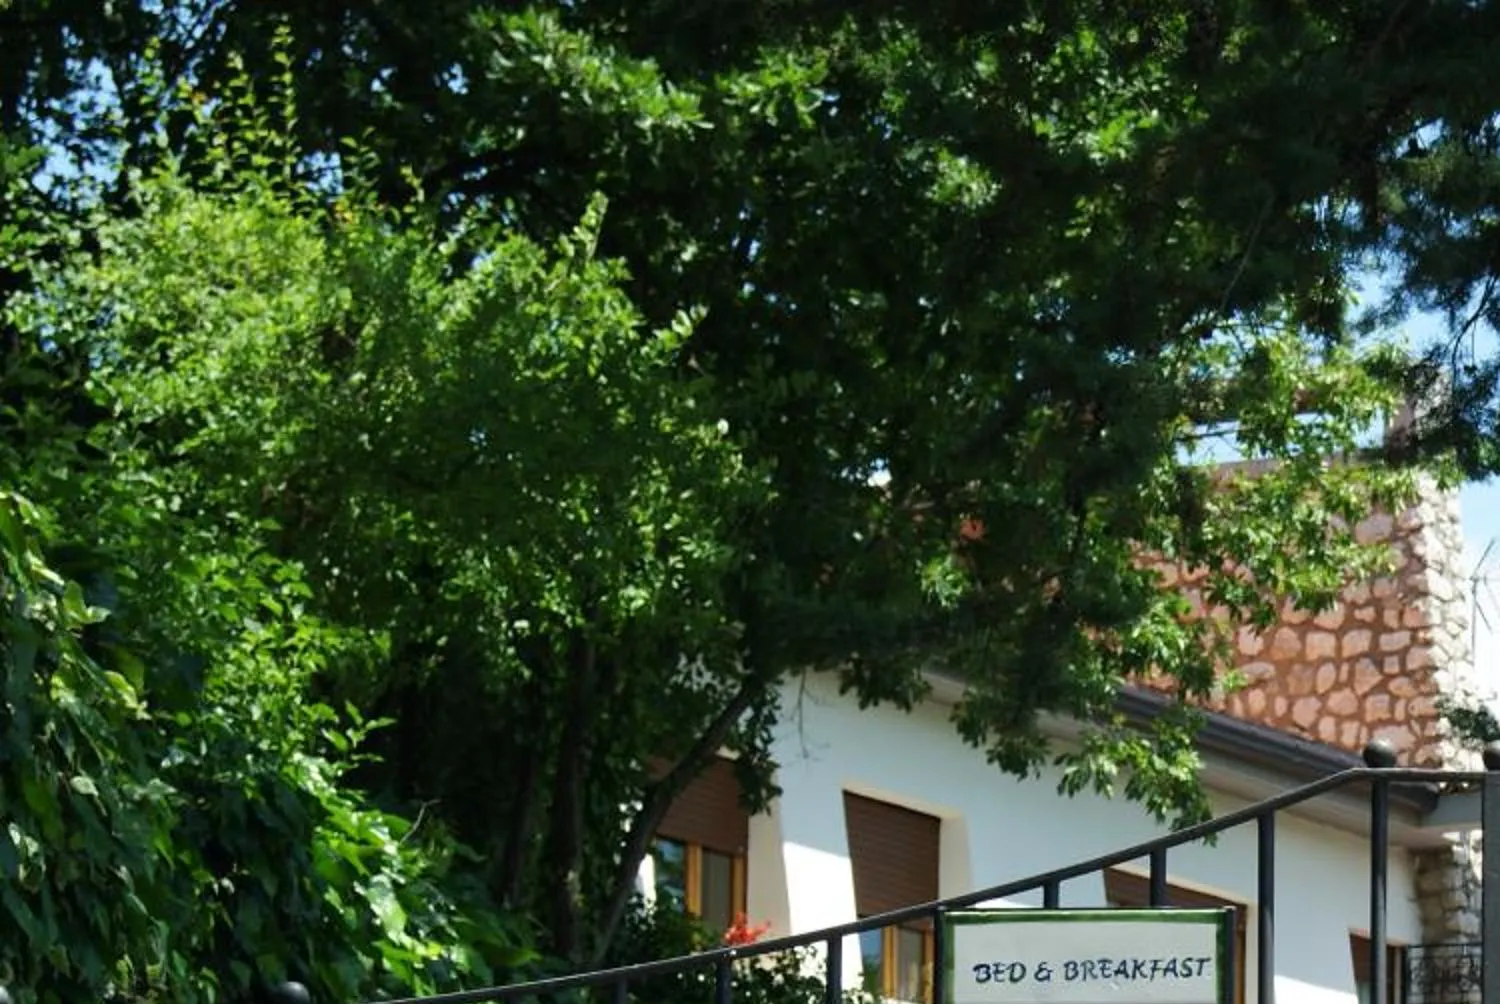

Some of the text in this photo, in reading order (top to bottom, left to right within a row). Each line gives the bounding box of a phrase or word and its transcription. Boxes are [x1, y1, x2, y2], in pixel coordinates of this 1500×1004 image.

[973, 957, 1211, 984] BED & BREAKFAST
